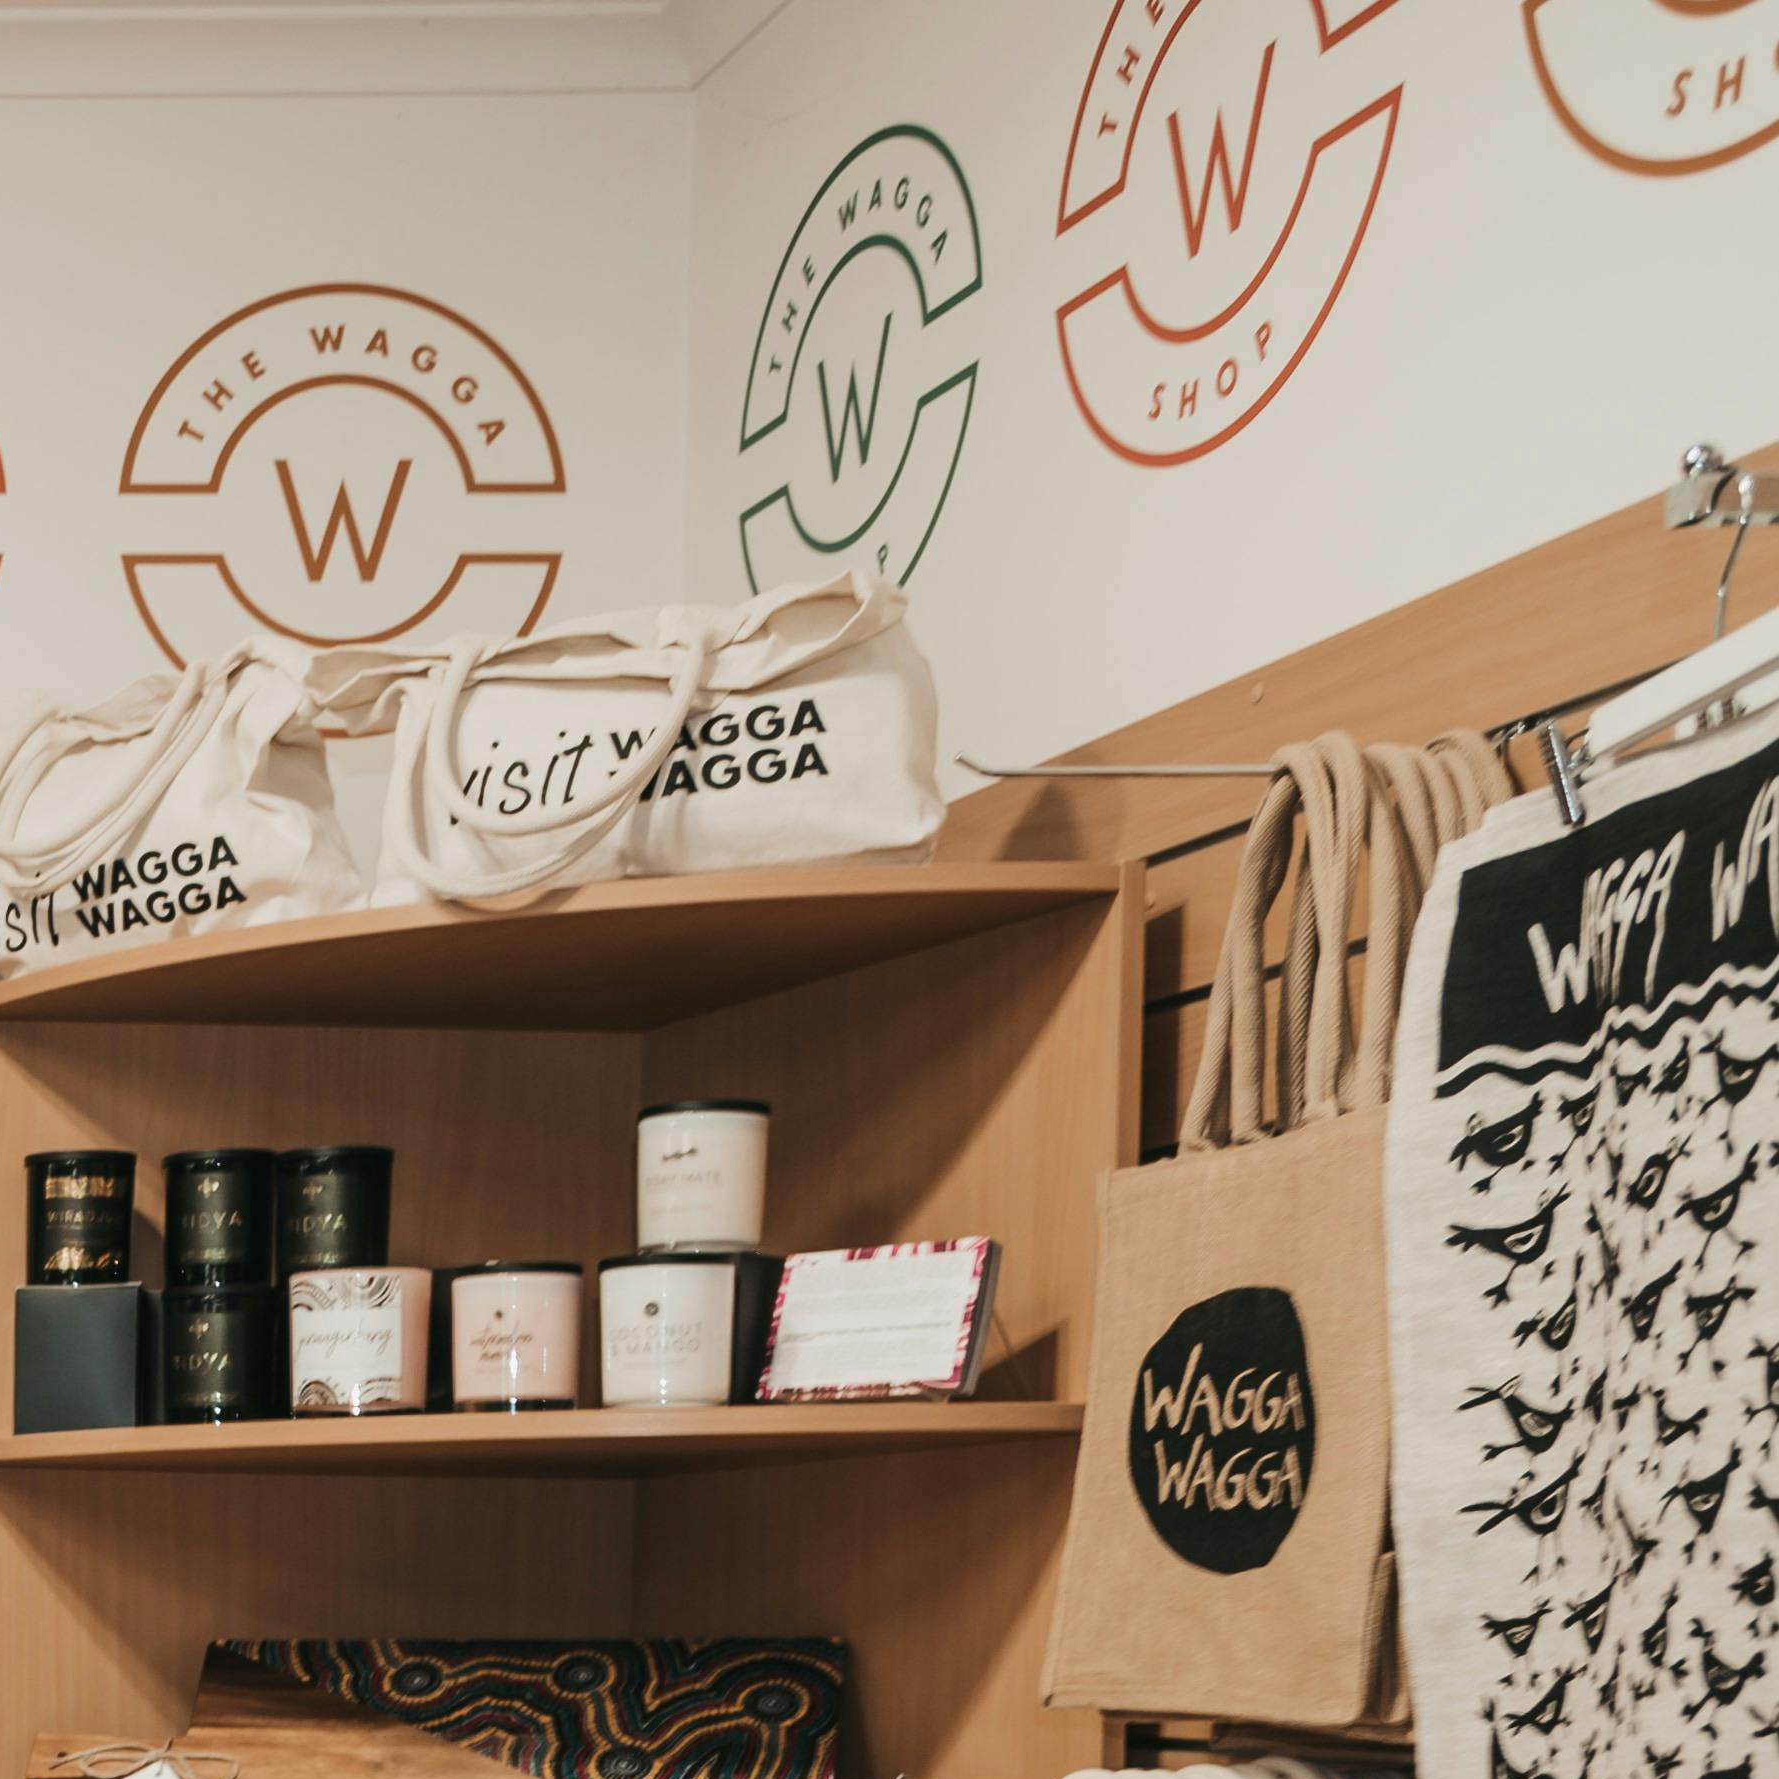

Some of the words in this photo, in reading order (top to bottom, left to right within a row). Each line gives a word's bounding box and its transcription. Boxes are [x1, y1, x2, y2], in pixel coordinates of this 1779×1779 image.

[1167, 40, 1276, 259] W
[768, 256, 816, 375] THE
[838, 177, 948, 265] WAGGA
[178, 351, 266, 441] THE
[309, 325, 505, 446] WAGGA
[817, 312, 893, 484] W
[1147, 321, 1273, 421] SHOP
[274, 459, 412, 582] W
[71, 836, 238, 903] WAGGA
[75, 875, 248, 938] WAGGA
[1143, 1342, 1307, 1437] WAGGA
[1154, 1432, 1304, 1512] WAGGA
